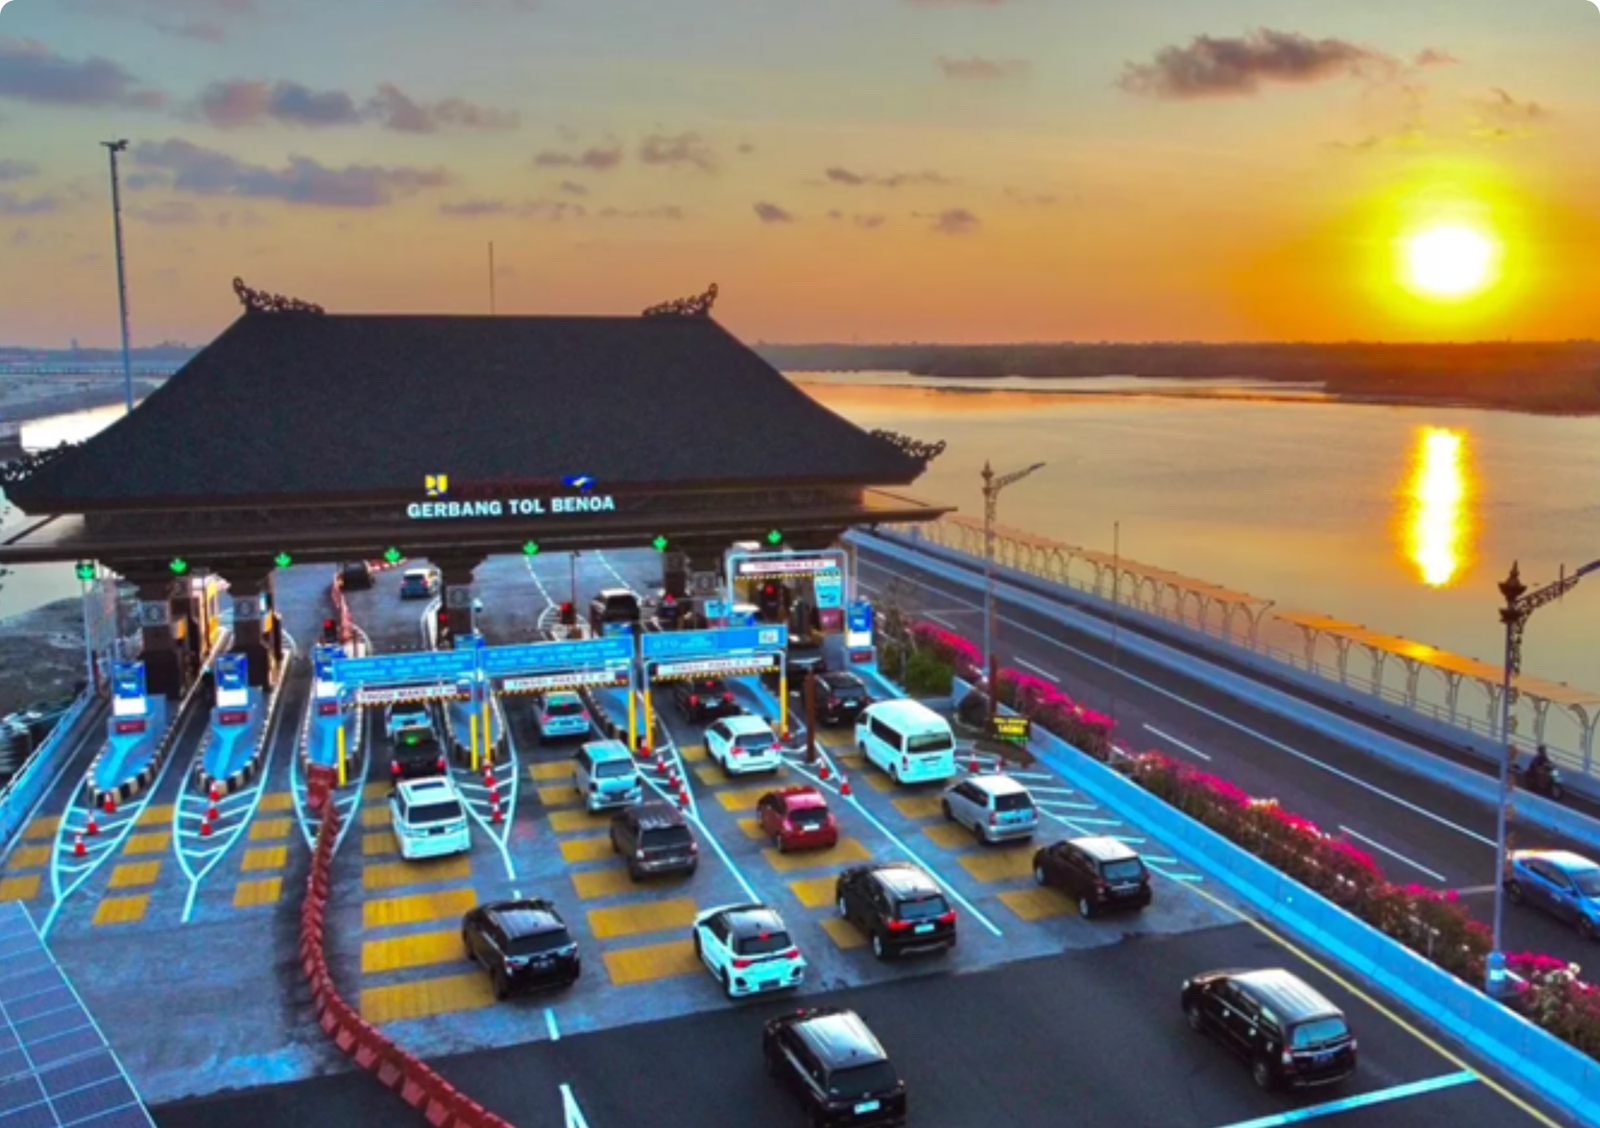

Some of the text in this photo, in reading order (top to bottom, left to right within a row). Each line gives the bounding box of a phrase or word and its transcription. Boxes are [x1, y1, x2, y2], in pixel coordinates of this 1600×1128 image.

[407, 495, 615, 519] GERBANG TOL BENOA
